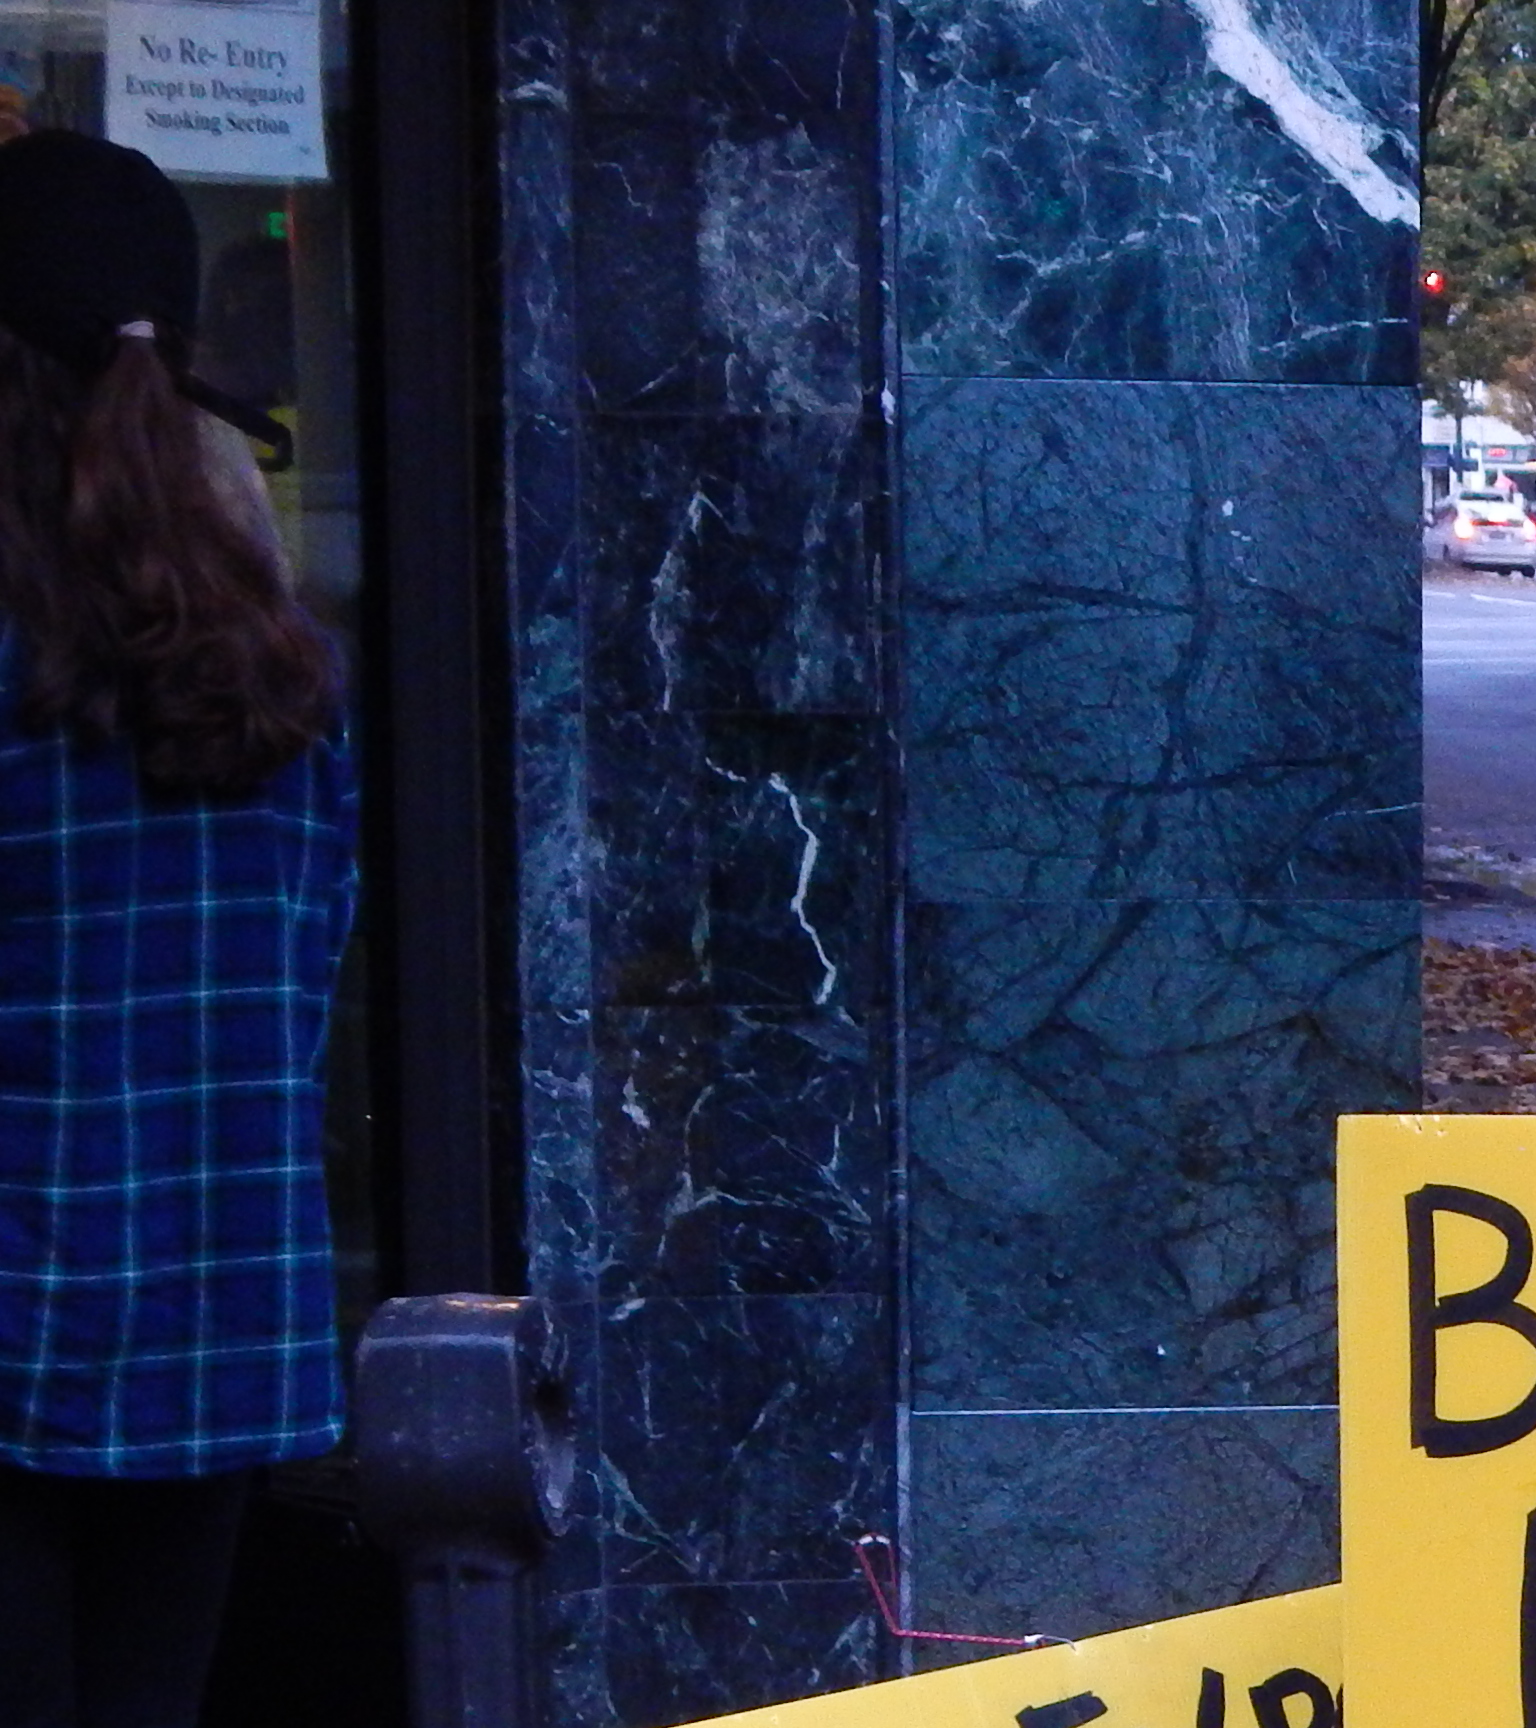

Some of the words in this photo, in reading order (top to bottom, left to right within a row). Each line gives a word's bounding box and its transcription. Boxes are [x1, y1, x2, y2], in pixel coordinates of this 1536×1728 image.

[139, 35, 172, 62] No
[226, 40, 288, 77] Entry
[126, 75, 184, 103] Except
[189, 80, 206, 99] to
[211, 79, 305, 106] Designated
[145, 108, 222, 136] Smoking
[226, 112, 291, 135] Section
